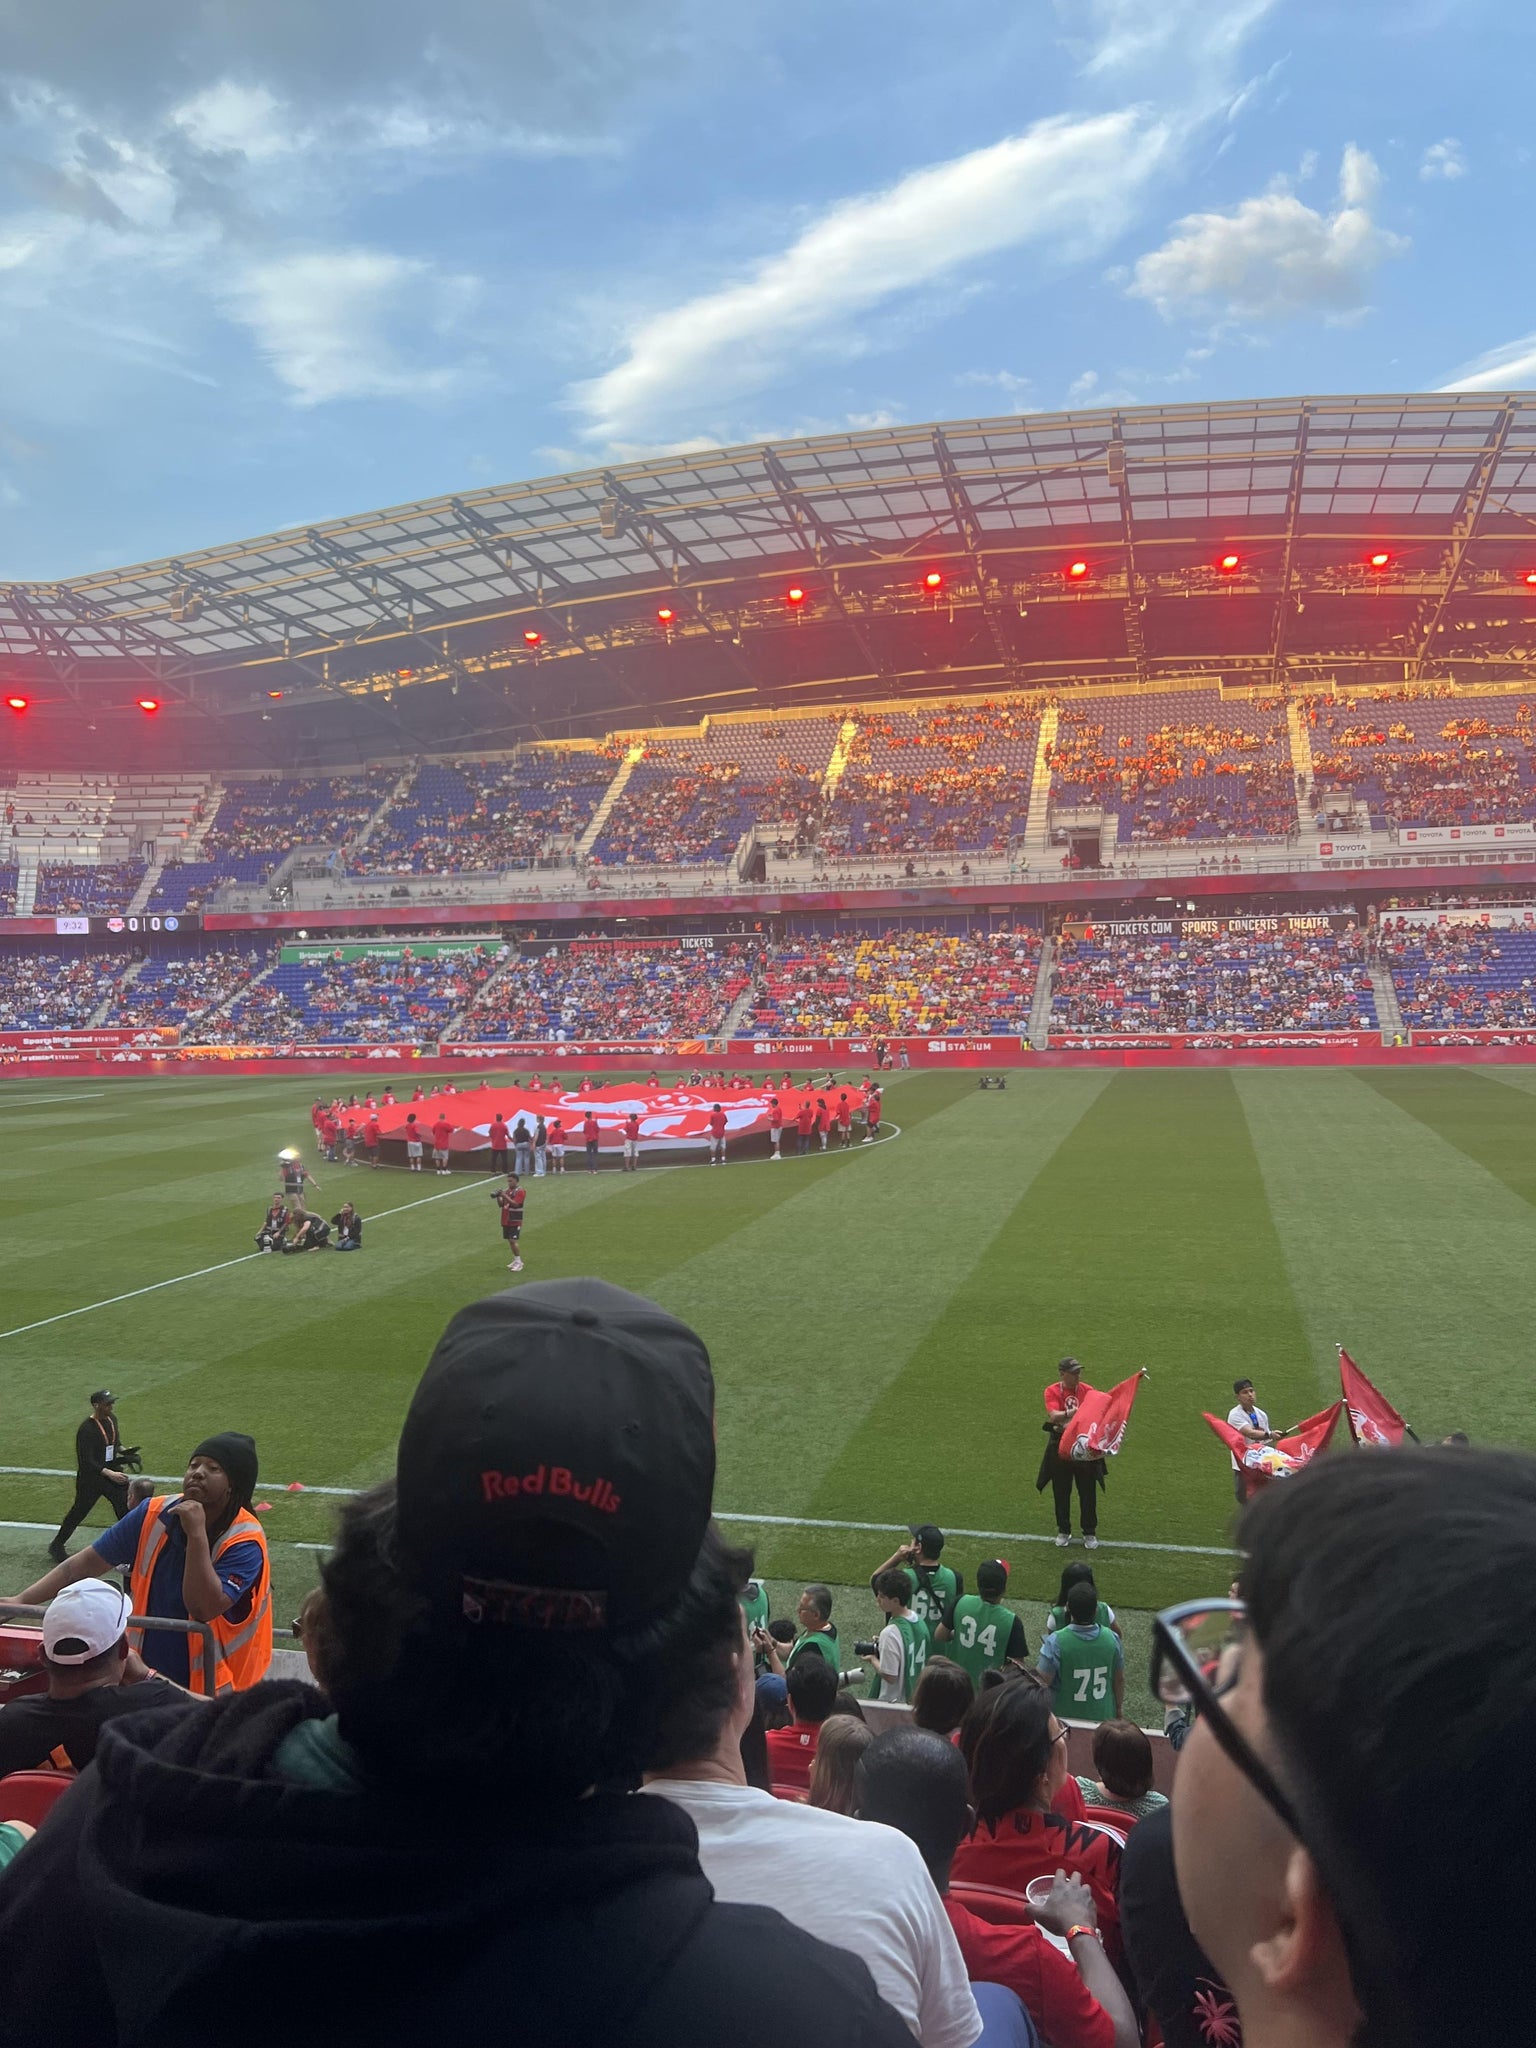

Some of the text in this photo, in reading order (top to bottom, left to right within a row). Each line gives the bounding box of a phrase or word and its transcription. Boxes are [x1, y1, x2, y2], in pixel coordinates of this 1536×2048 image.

[63, 921, 83, 930] 9:32
[128, 917, 161, 932] 0 0
[1181, 920, 1218, 933] SPORTS
[1228, 918, 1278, 932] CONCERTS
[1288, 916, 1330, 930] THEATER
[681, 937, 714, 949] TICKETS
[947, 1042, 992, 1051] STAIUM
[481, 1464, 622, 1513] Red Bulls
[910, 1590, 946, 1621] 65
[960, 1615, 997, 1657] 34
[908, 1639, 927, 1677] 14
[1073, 1666, 1108, 1702] 75
